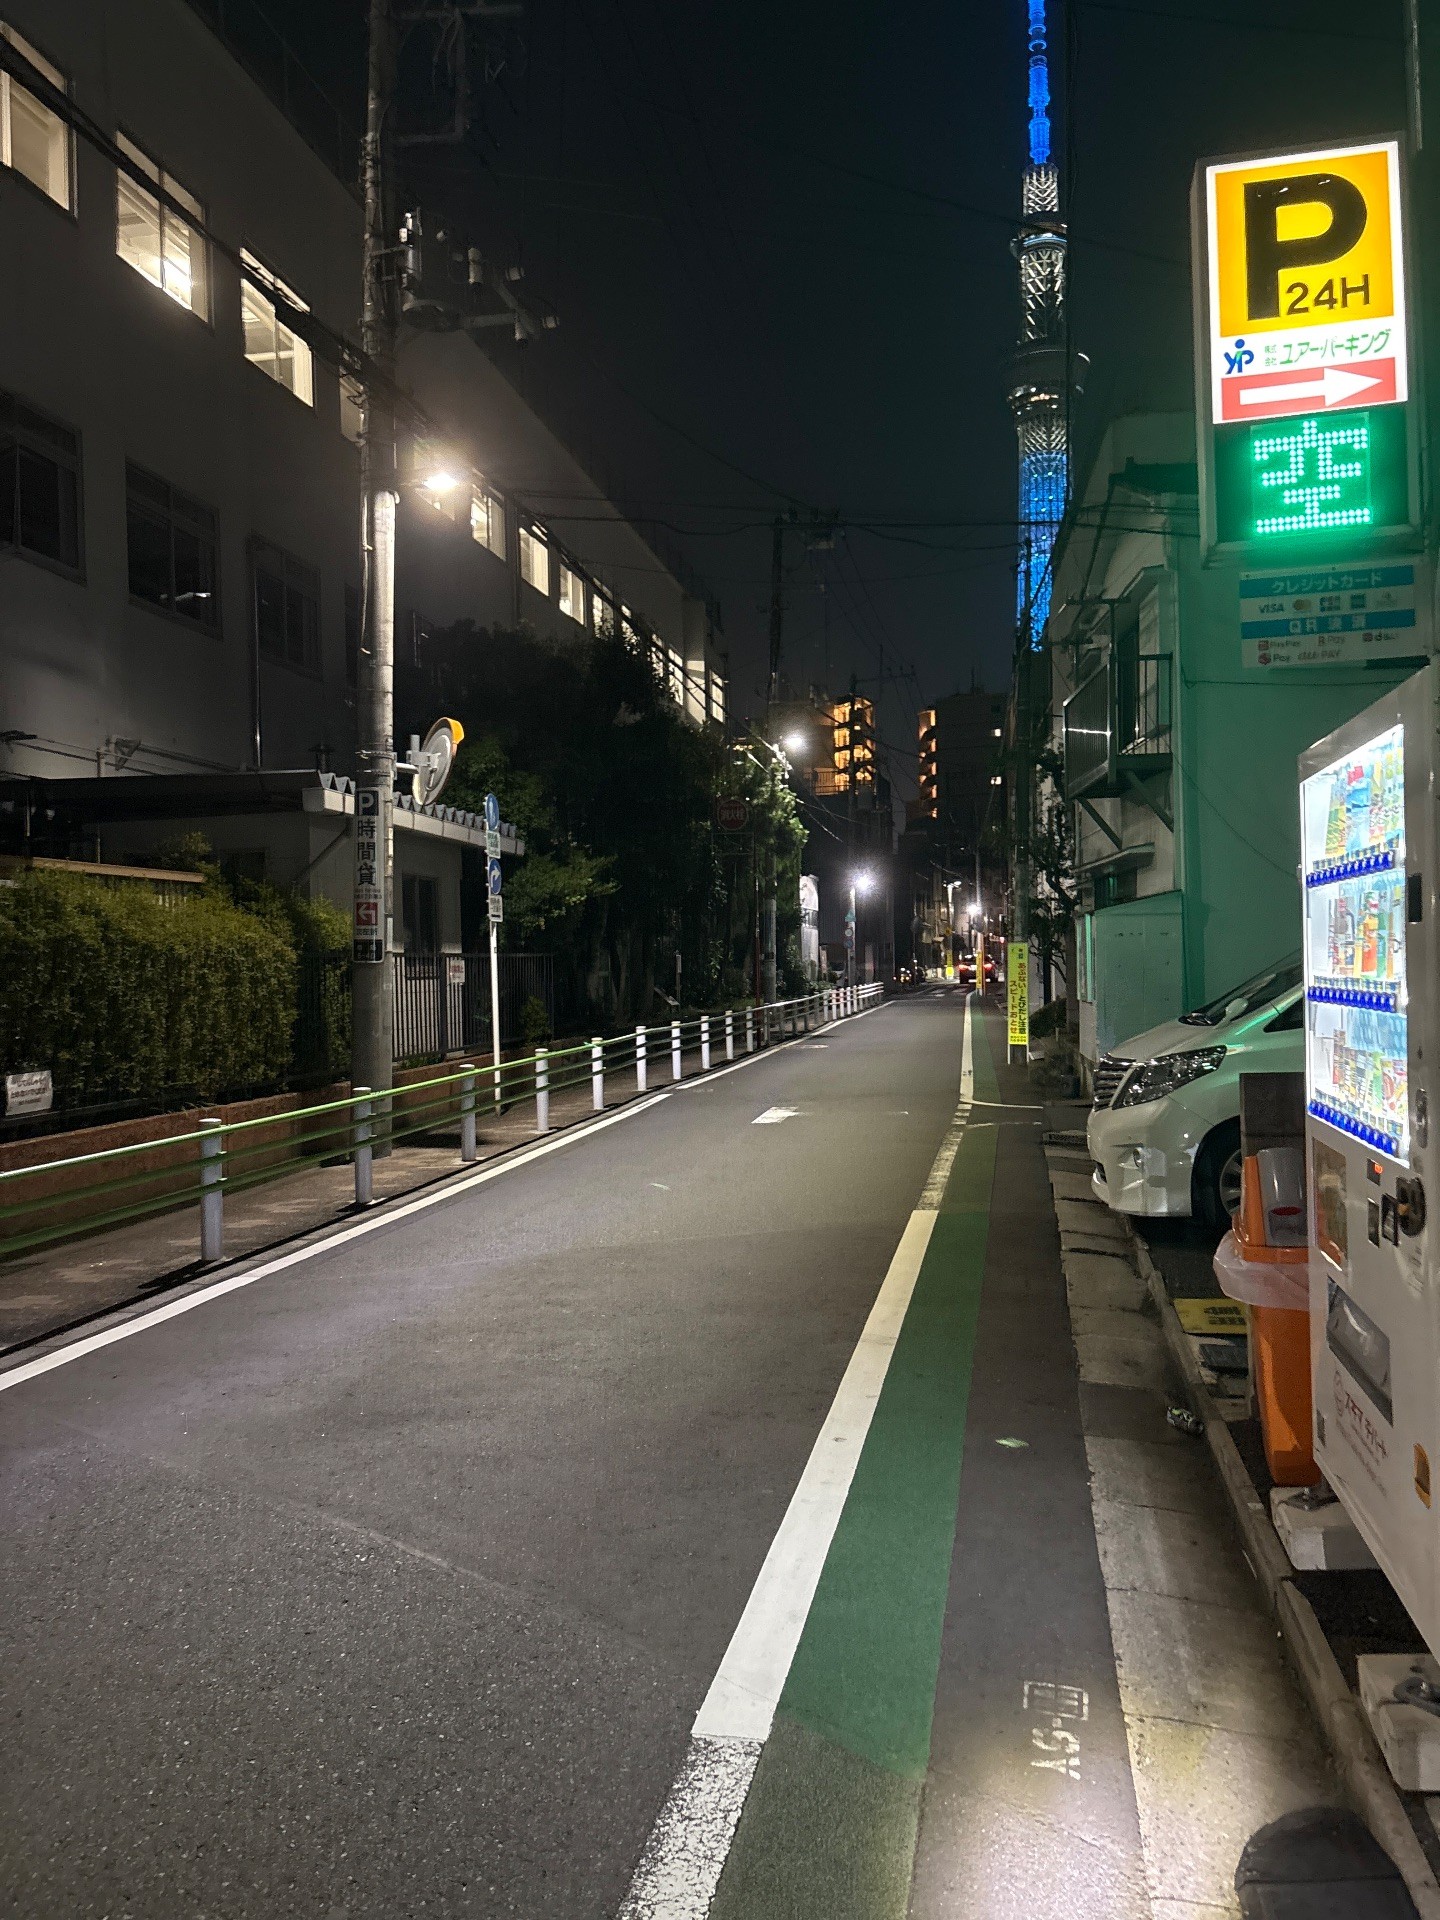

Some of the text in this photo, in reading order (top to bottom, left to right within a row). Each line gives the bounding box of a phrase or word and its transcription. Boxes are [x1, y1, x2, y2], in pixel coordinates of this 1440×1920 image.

[1243, 172, 1368, 322] P
[1285, 273, 1371, 316] 24H
[1253, 419, 1371, 534] 空
[1271, 571, 1383, 594] クレジットカード
[1258, 602, 1285, 614] VISA
[1273, 653, 1291, 663] Pay
[358, 792, 375, 816] P
[357, 818, 376, 886] 時間貸
